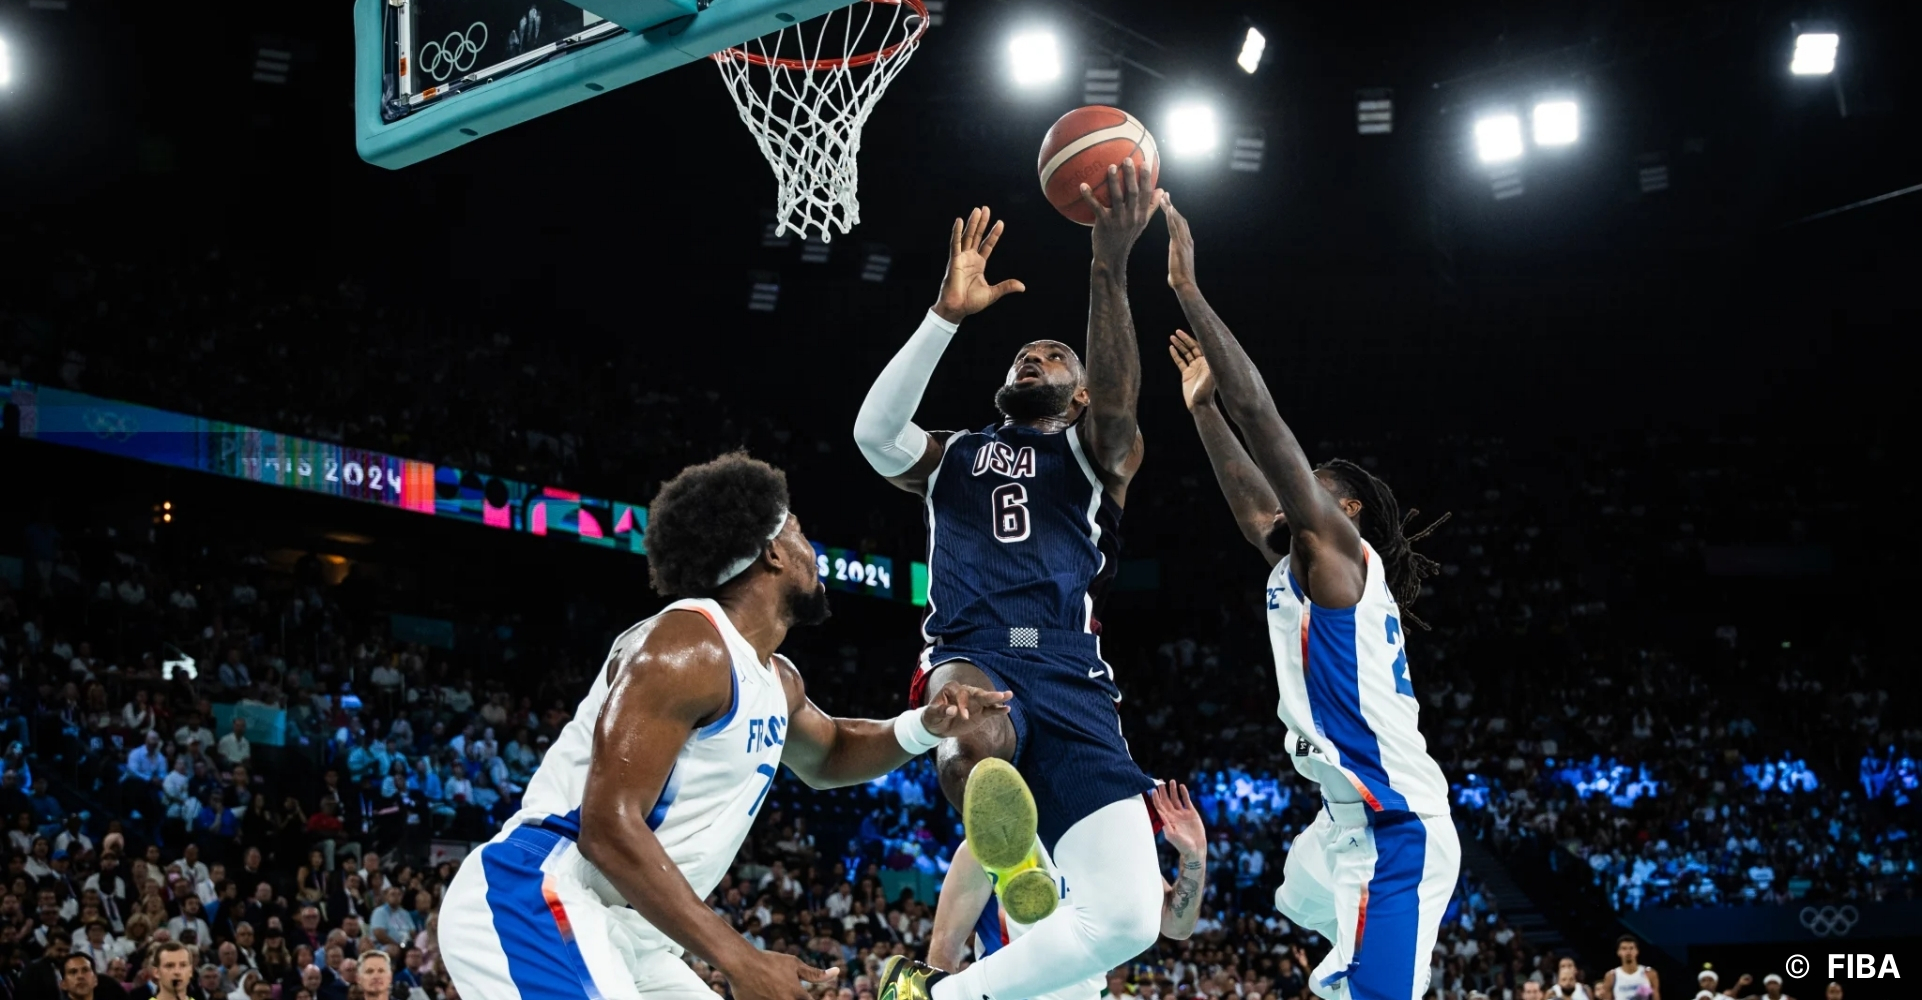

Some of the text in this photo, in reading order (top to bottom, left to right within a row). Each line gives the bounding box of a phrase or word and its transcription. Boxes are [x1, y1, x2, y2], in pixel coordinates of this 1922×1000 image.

[325, 457, 402, 494] 2024
[972, 441, 1036, 478] USA
[991, 482, 1031, 543] 6
[834, 557, 891, 589] 2024
[748, 763, 776, 817] 7
